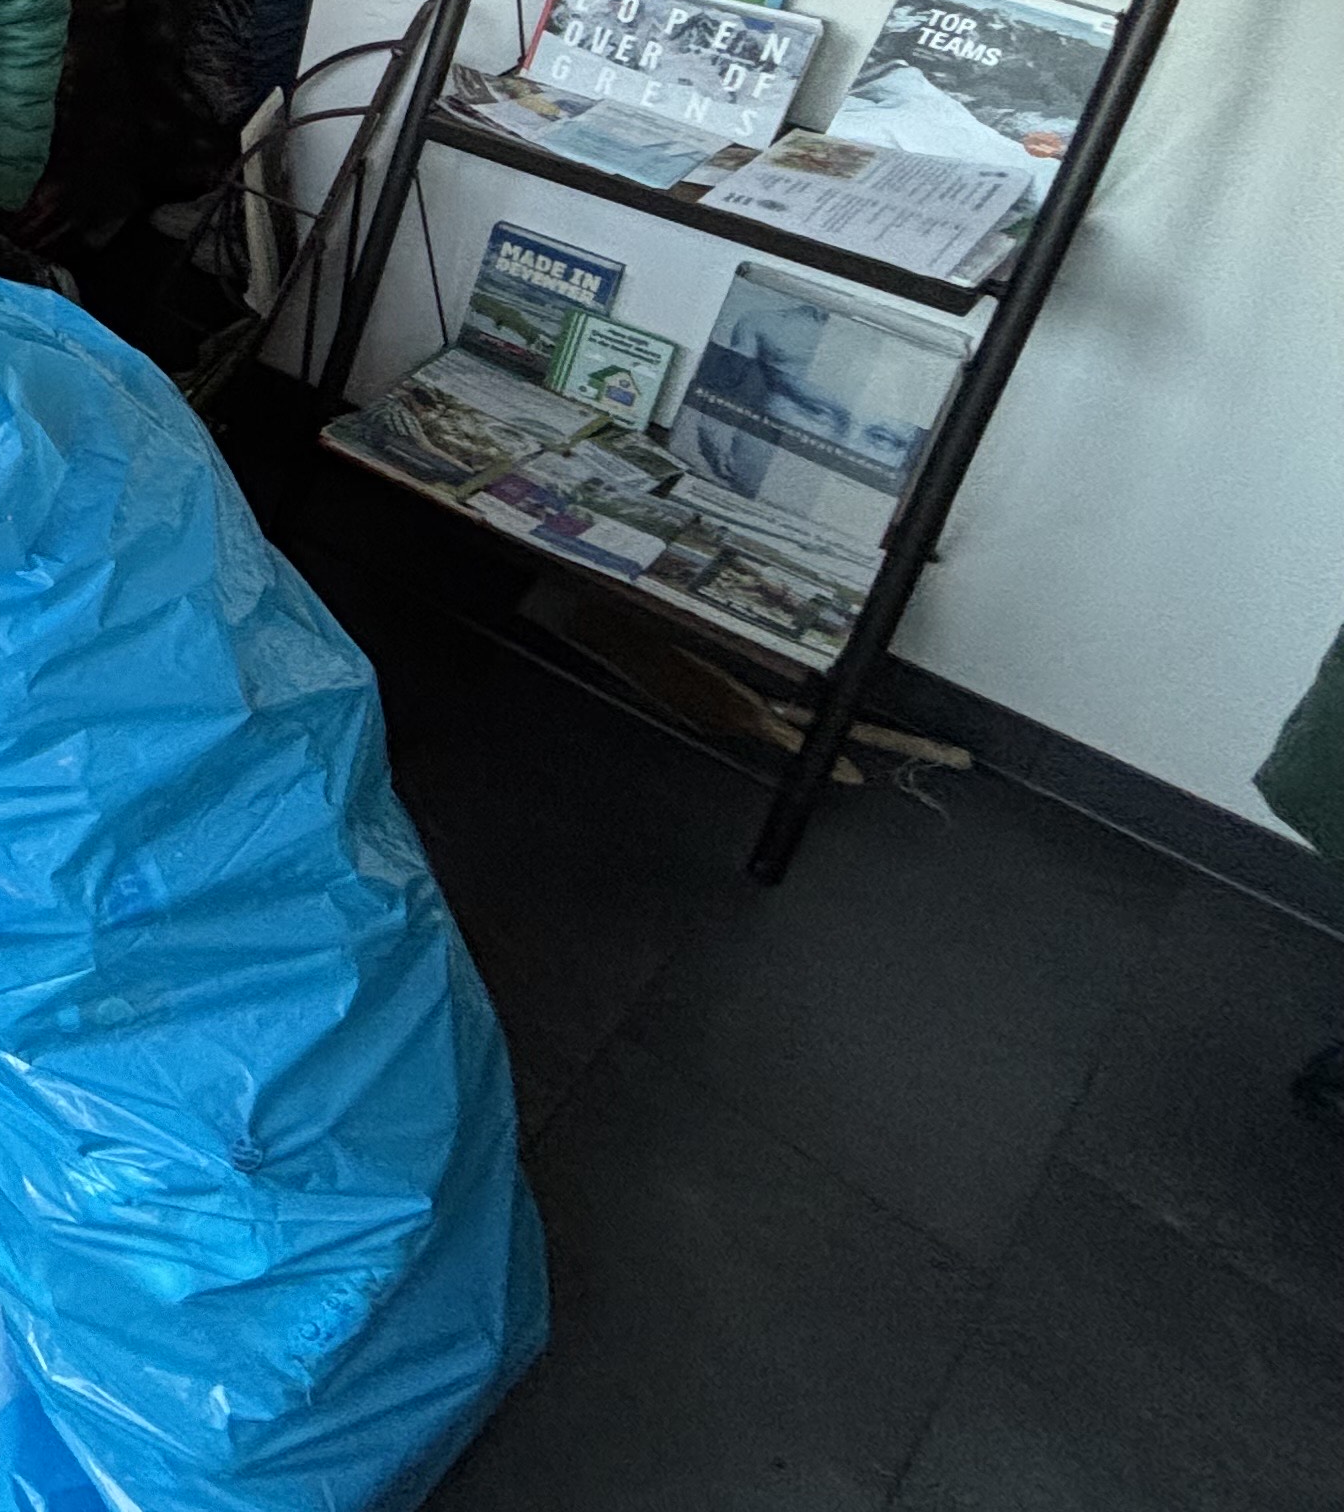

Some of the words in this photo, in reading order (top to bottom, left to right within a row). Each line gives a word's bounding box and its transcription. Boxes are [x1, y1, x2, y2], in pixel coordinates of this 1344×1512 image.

[565, 19, 663, 70] OVER
[916, 26, 1002, 67] TEAMS
[927, 8, 978, 35] TOP
[551, 54, 761, 138] GRENS
[499, 241, 567, 277] MADE
[570, 267, 603, 293] IN
